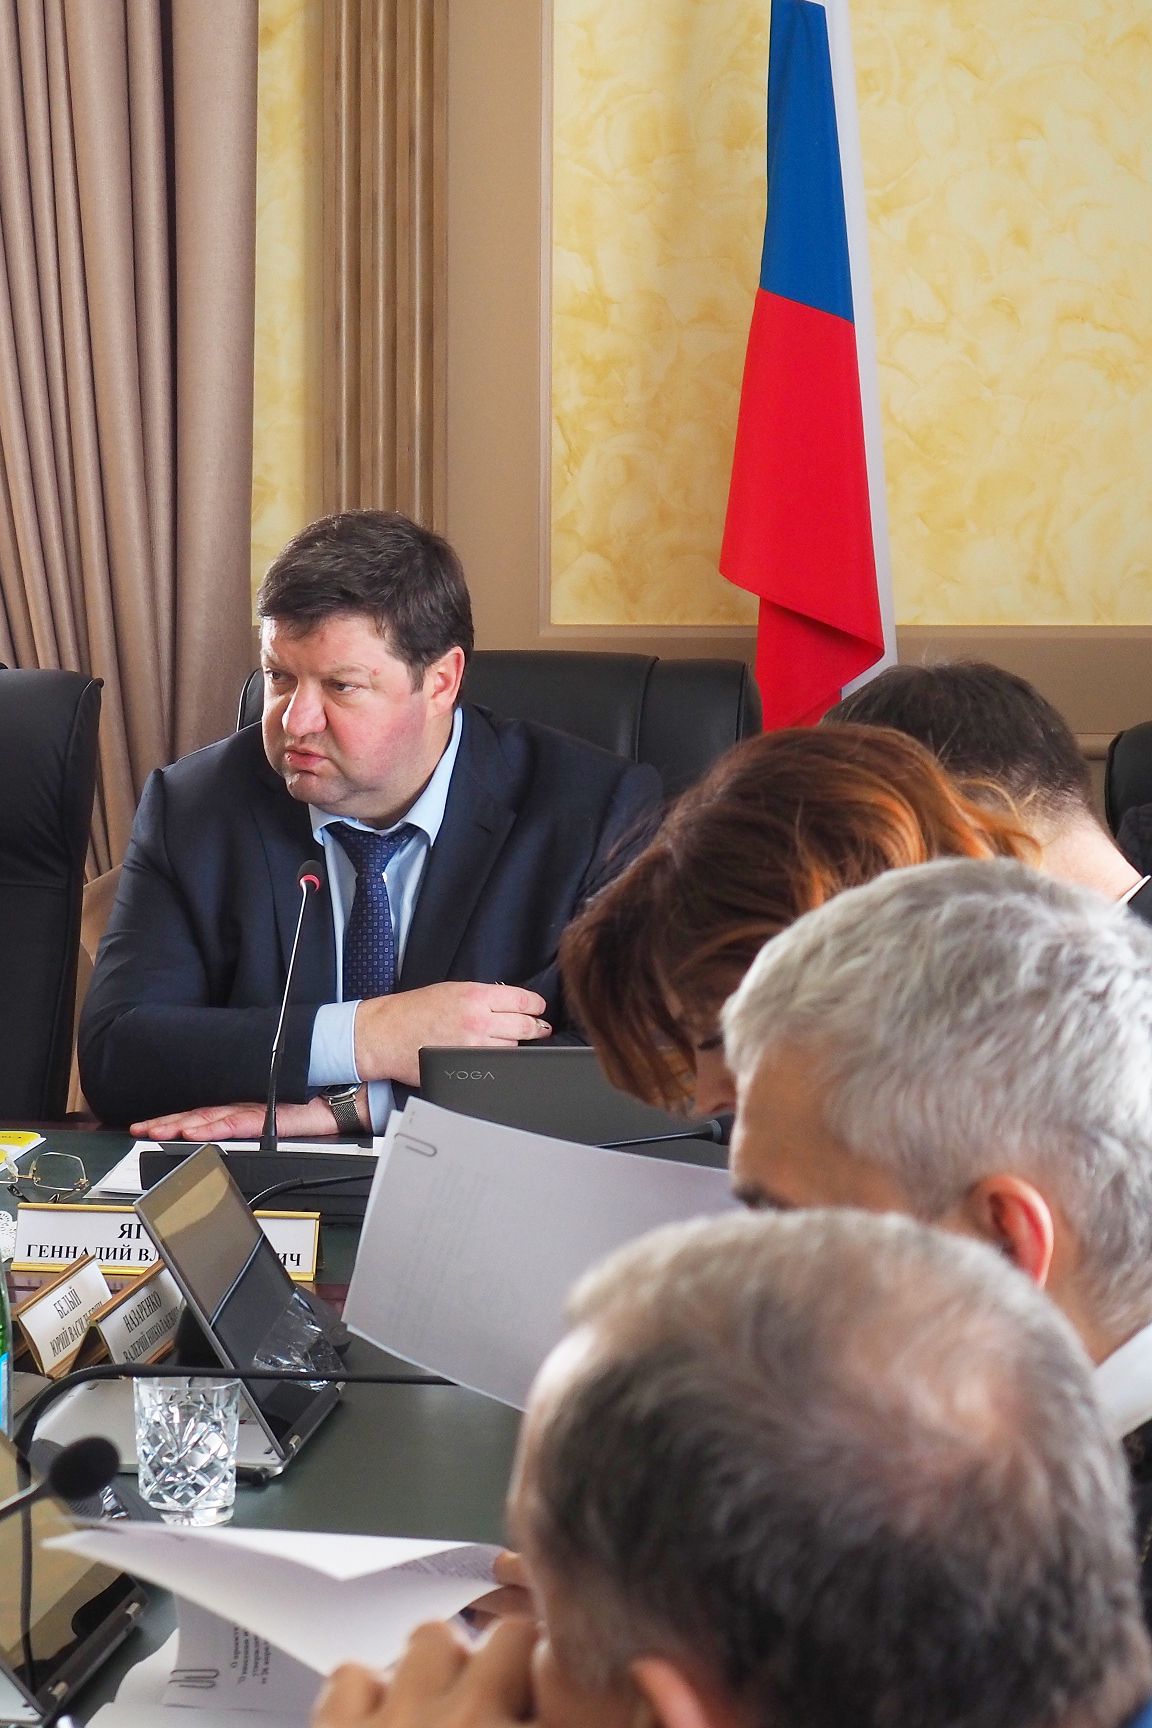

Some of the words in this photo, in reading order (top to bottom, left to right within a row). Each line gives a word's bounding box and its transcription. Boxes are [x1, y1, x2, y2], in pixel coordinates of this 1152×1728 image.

[444, 1070, 495, 1080] YOGA
[53, 1286, 82, 1319] БЕЛЫЙ
[122, 1290, 162, 1333] НАЗАРЕНКО
[49, 1327, 71, 1357] ЮРИЙ
